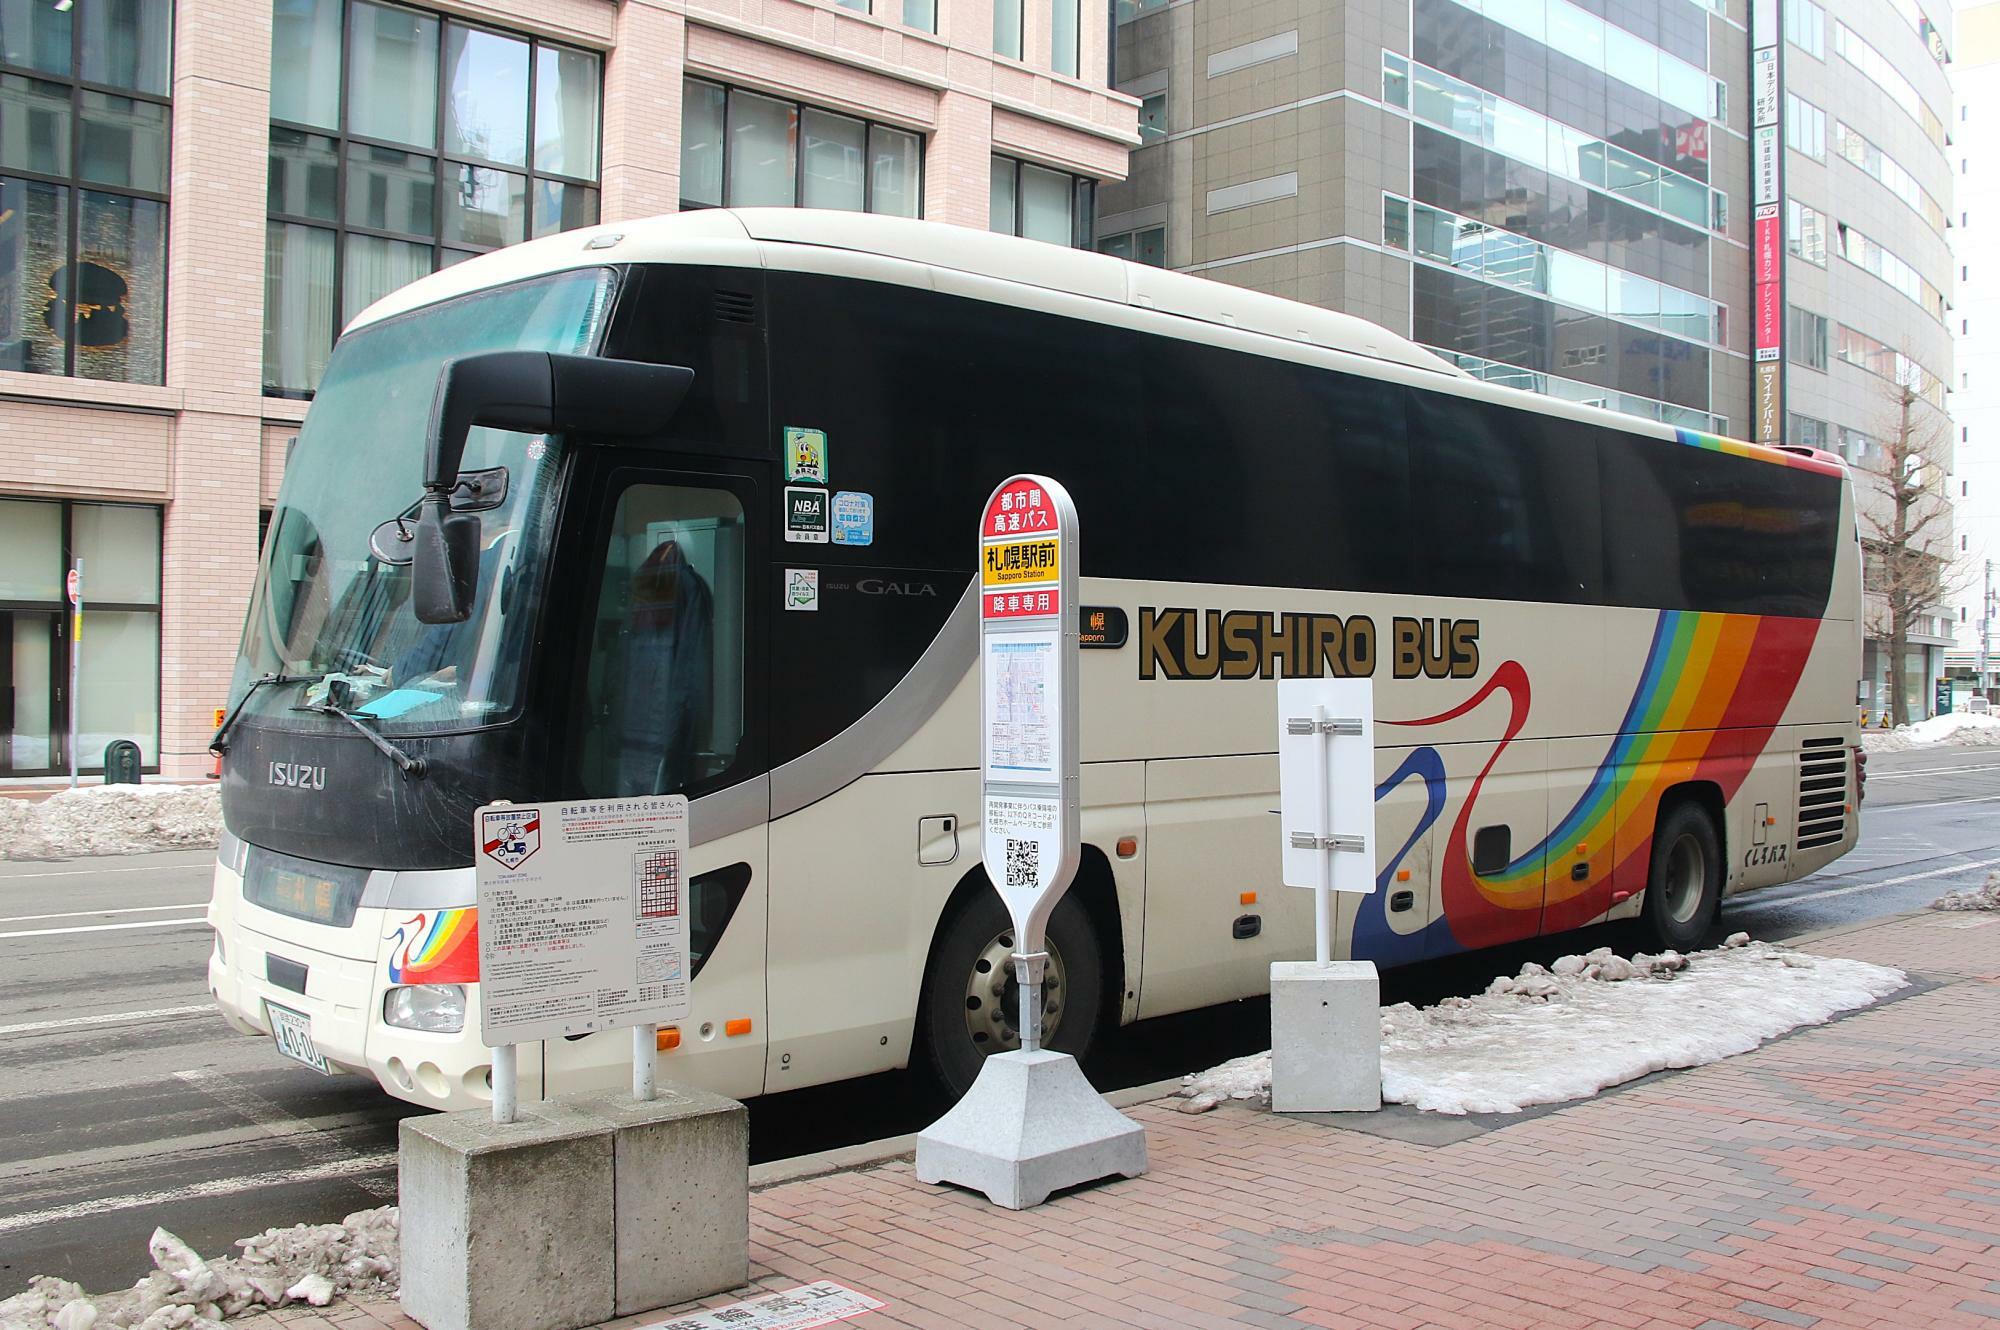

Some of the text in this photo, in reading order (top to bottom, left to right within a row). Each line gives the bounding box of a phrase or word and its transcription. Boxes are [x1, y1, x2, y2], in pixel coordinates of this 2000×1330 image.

[793, 499, 821, 513] NBA
[1000, 488, 1041, 512] 都市間
[993, 510, 1048, 533] 高速バス
[987, 542, 1056, 572] 札幌駅前
[997, 570, 1045, 582] Sapporo Station
[856, 579, 937, 597] GALA
[993, 593, 1050, 614] 降車専用
[1138, 607, 1480, 681] KUSHIRO BUS
[269, 761, 326, 792] ISUZU
[1744, 843, 1787, 868] くしろバス
